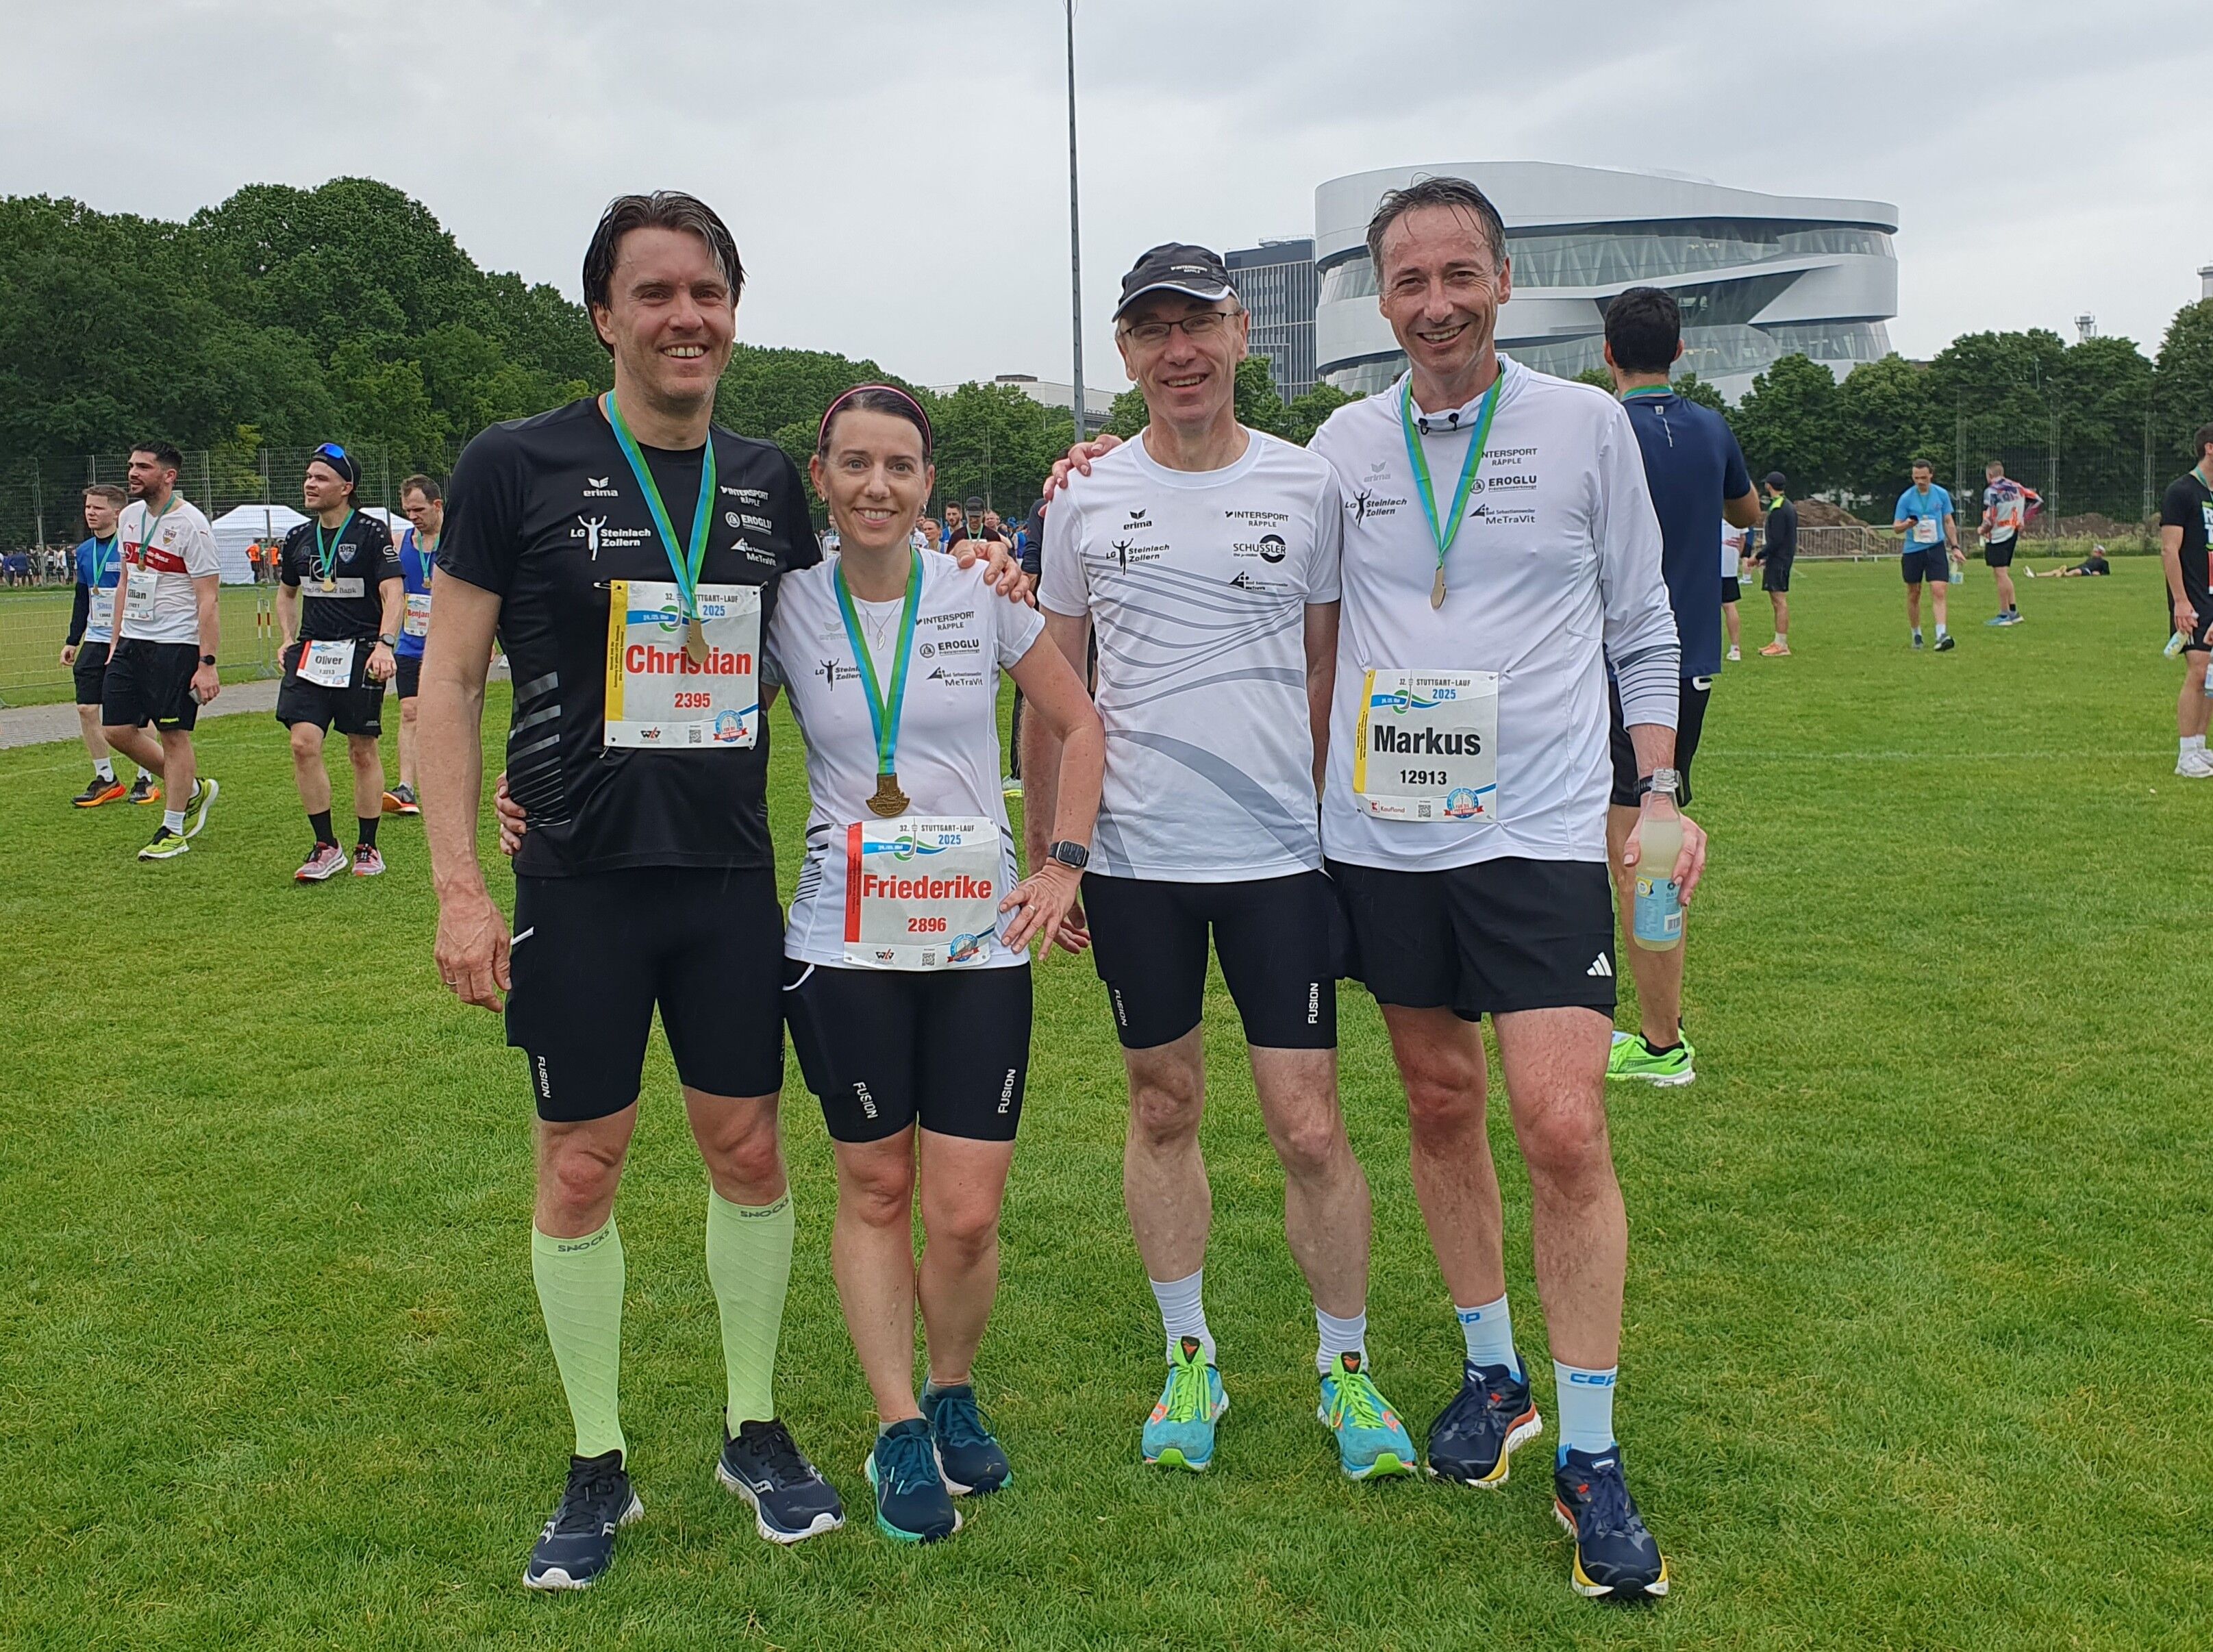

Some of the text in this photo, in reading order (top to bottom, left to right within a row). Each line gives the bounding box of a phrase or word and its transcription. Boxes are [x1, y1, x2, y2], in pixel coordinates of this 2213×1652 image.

[1481, 448, 1538, 458] NTERSPORT
[1488, 475, 1537, 486] EROGLU
[584, 489, 618, 497] erima
[728, 488, 769, 501] INTERSPORT
[1366, 498, 1408, 508] Steinlach
[1234, 511, 1289, 523] INTERSPORT
[1366, 508, 1396, 517] Zollern
[740, 514, 773, 529] EROGLU
[1486, 515, 1536, 525] MeTraVit
[1123, 521, 1153, 531] erima
[571, 529, 586, 538] LG
[600, 528, 651, 538] Steinlach
[601, 538, 641, 547] Zollern
[1129, 544, 1170, 555] Steinlach
[1106, 551, 1116, 560] LG
[1129, 553, 1160, 563] Zollern
[696, 594, 738, 603] TTGART-LAUF
[703, 605, 725, 616] 2025
[923, 611, 975, 625] INTERSPORT
[938, 639, 979, 651] EROGLU
[315, 655, 343, 665] Oliver
[625, 644, 752, 675] Christian
[945, 678, 983, 687] MeTraVit
[1432, 689, 1456, 699] 2025
[674, 692, 711, 708] 2395
[1374, 725, 1481, 756] Markus
[1399, 770, 1447, 785] 12913
[938, 834, 962, 845] 2025
[863, 874, 992, 899] Friederike
[908, 917, 947, 932] 2896
[1114, 989, 1128, 1027] FUSION
[1308, 982, 1319, 1025] FUSION
[537, 1055, 551, 1099] FUSION
[997, 1068, 1016, 1114] FUSION
[853, 1081, 879, 1120] FUSION
[740, 1197, 790, 1218] SNOCKS
[557, 1228, 610, 1253] SNOCKS
